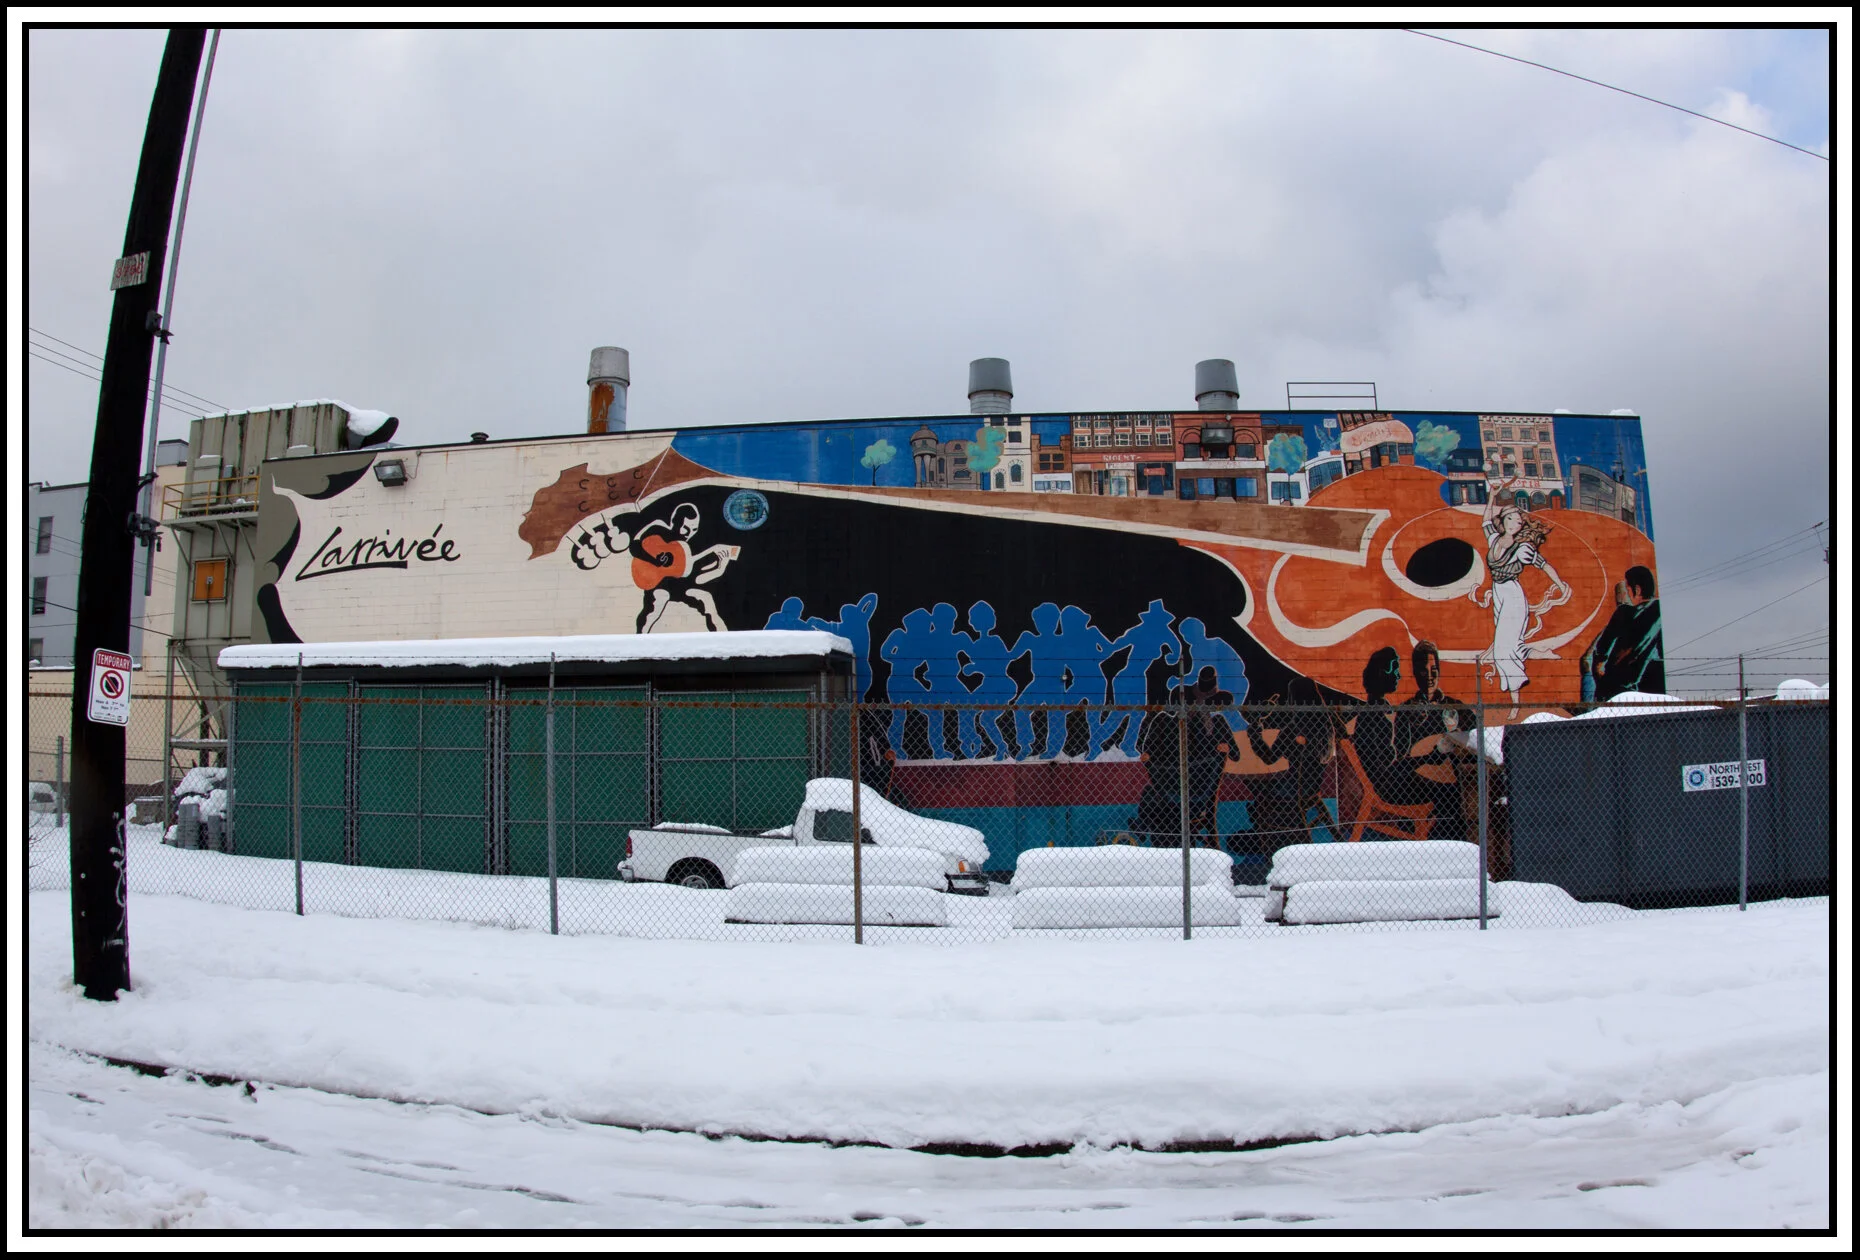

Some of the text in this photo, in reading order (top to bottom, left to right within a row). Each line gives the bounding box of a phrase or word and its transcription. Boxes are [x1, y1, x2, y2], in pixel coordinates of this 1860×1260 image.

[295, 523, 461, 582] Larrivée
[97, 653, 130, 670] TEMPORARY
[1709, 762, 1761, 775] NORTHEST
[1715, 773, 1763, 787] 539-00
